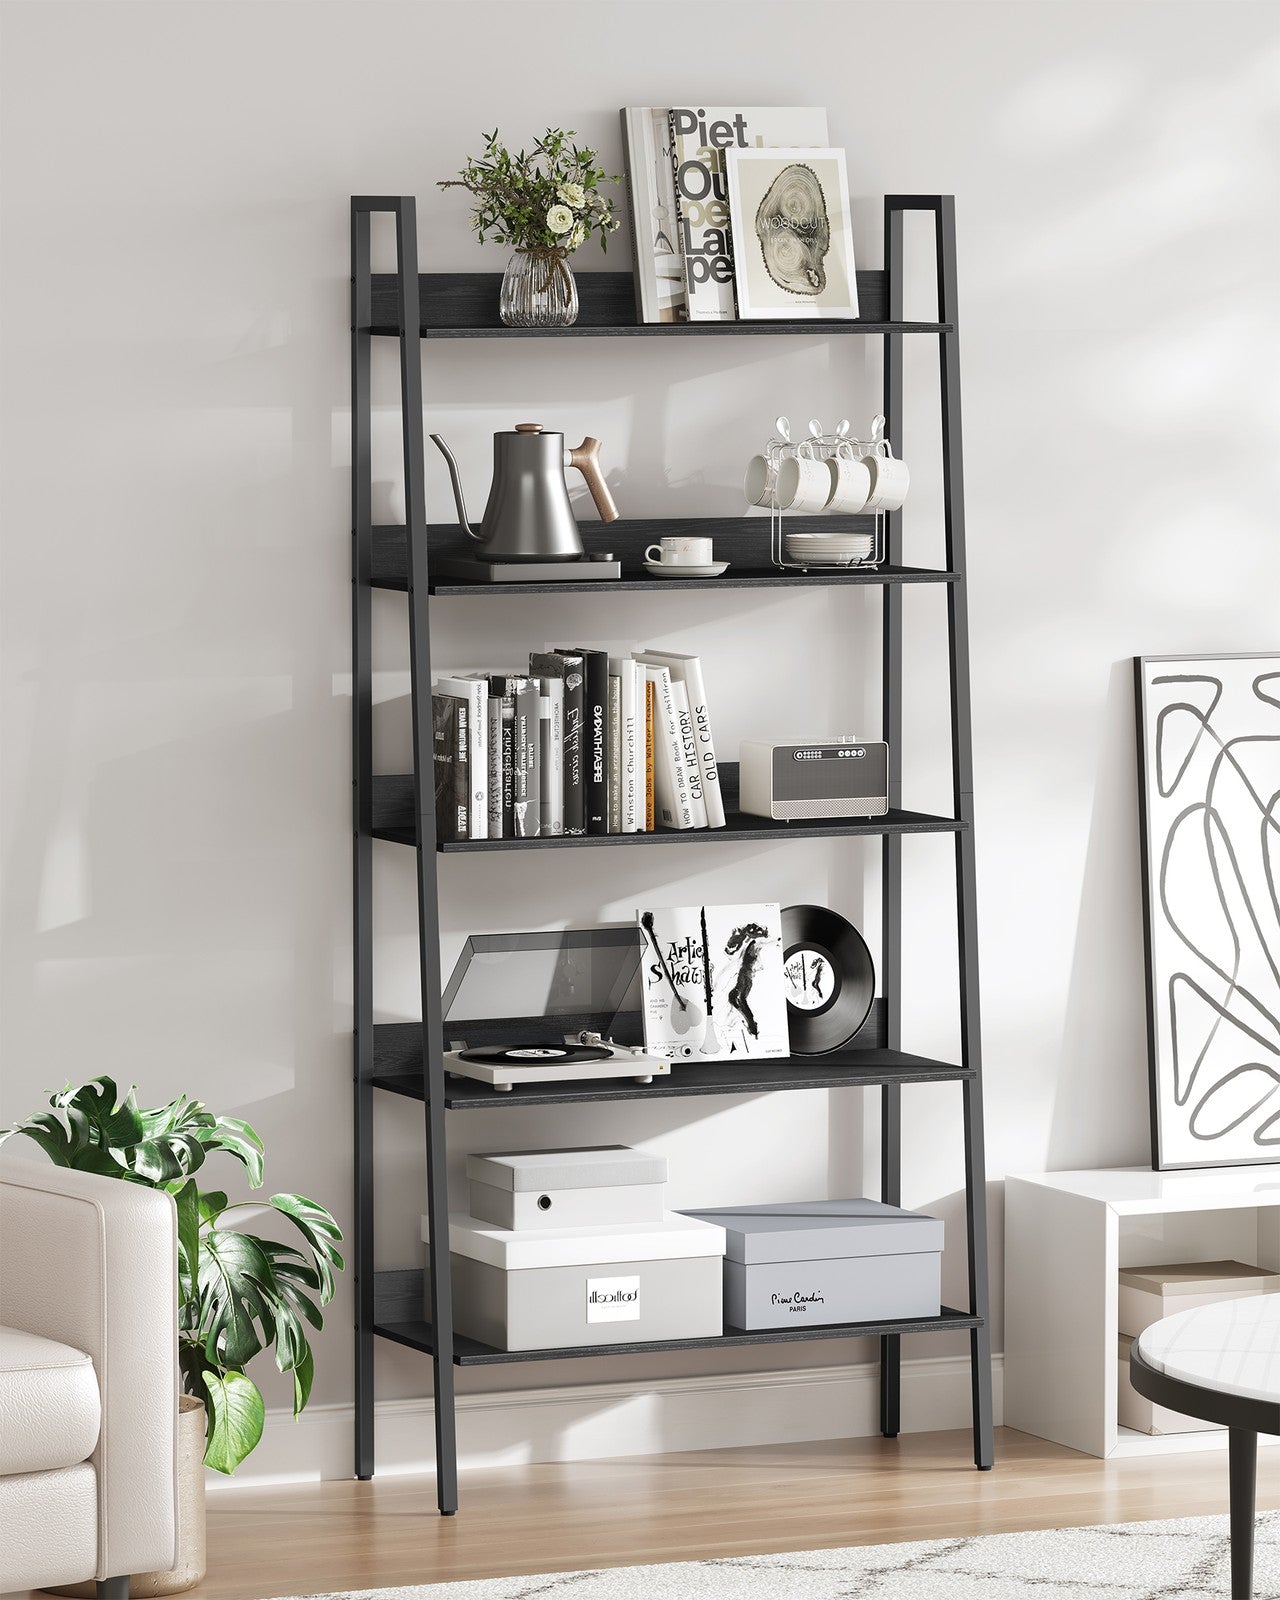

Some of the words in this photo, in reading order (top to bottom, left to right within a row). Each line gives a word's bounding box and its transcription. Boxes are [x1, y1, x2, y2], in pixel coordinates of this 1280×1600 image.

[673, 108, 749, 148] Piet
[678, 160, 729, 201] Ou
[760, 215, 826, 229] WOODCUT
[660, 672, 673, 715] children
[669, 720, 677, 735] for
[695, 705, 711, 743] CARS
[626, 716, 635, 774] Churchill
[671, 740, 681, 762] Book
[678, 709, 697, 767] HISTORY
[646, 762, 653, 773] by
[675, 766, 686, 788] DRAW
[703, 752, 717, 781] OLD
[679, 792, 688, 804] TO
[689, 774, 703, 800] CAR
[627, 779, 635, 825] Winston
[682, 807, 692, 825] HOW
[666, 937, 703, 965] Artie
[648, 961, 703, 990] Shaw
[789, 1305, 807, 1313] PARIS
[793, 1290, 825, 1304] Cardin
